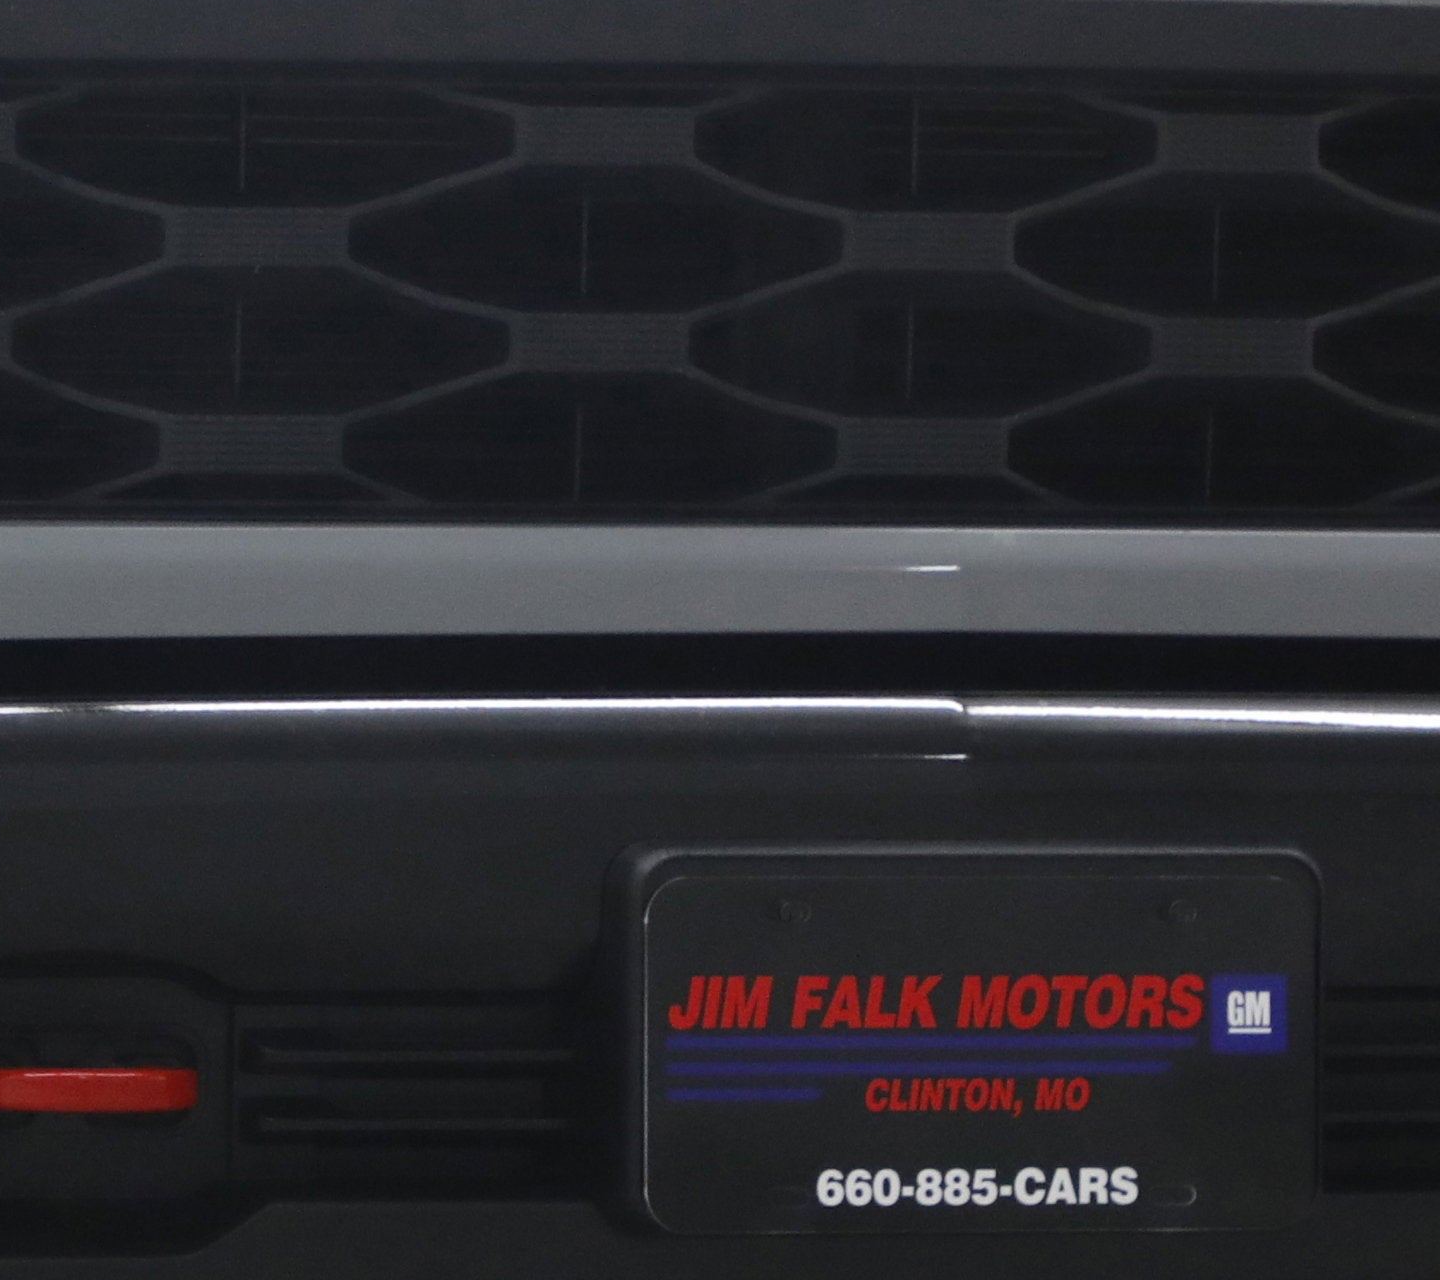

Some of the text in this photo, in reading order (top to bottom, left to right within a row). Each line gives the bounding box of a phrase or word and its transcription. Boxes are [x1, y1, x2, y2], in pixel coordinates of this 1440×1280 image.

[668, 974, 1205, 1029] JIM FALK MOTORS
[1227, 990, 1271, 1027] GM
[865, 1078, 1090, 1117] CLINTON, MO
[817, 1167, 1138, 1207] 660-885-CARS
